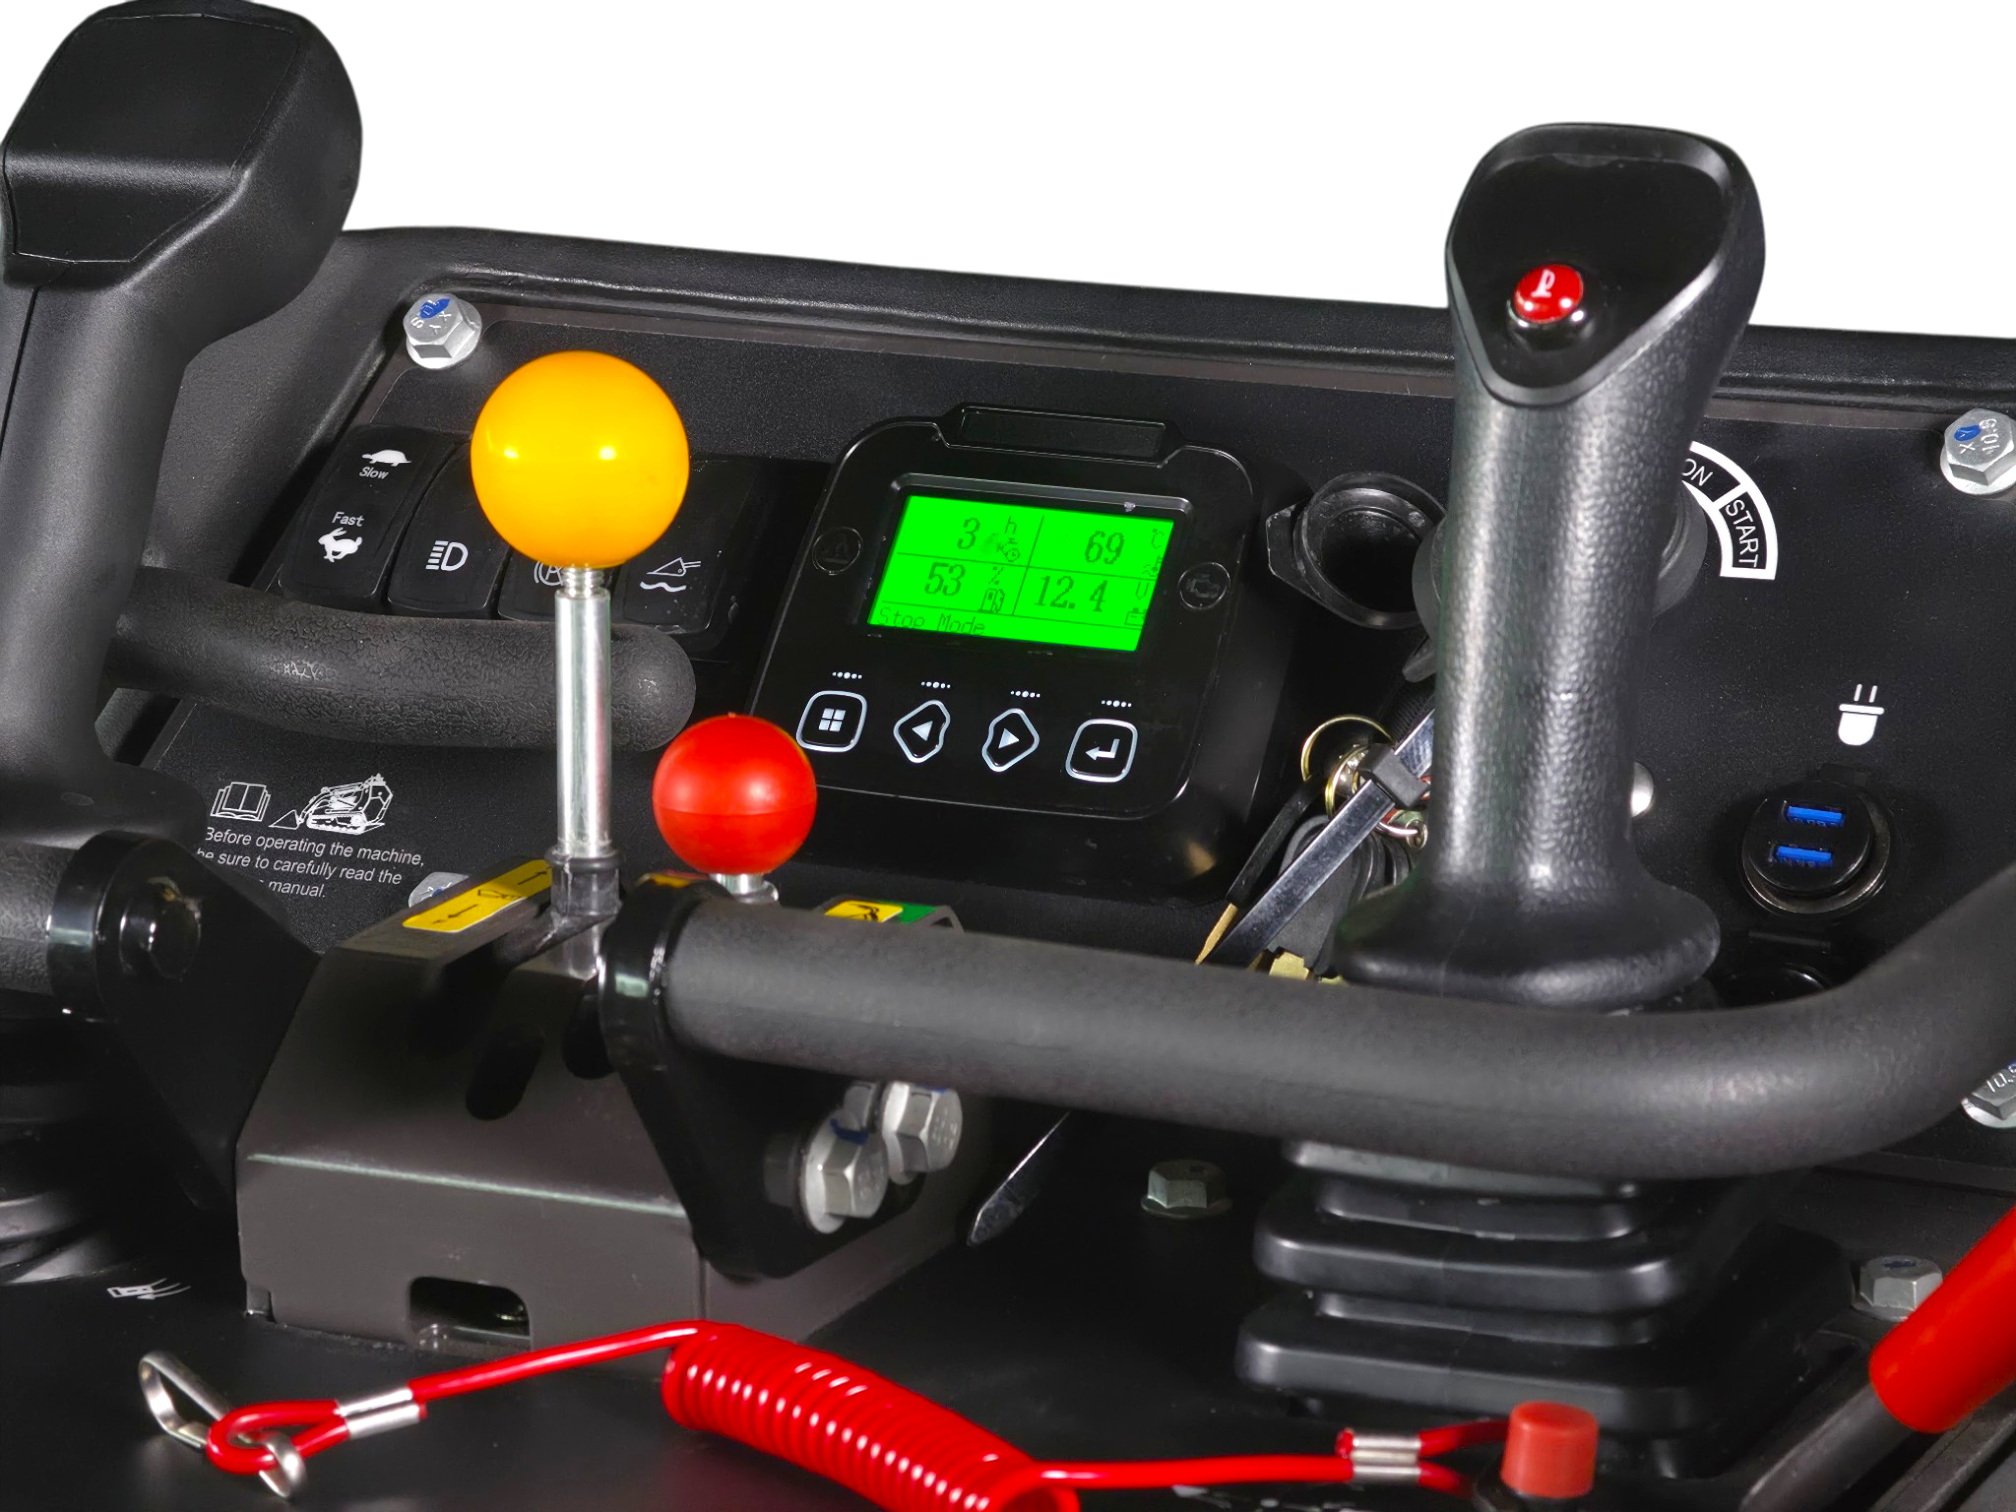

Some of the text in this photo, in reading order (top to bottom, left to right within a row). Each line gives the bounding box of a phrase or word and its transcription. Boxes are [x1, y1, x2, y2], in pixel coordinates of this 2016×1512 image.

[359, 466, 389, 480] Slow
[331, 511, 365, 527] Fast
[957, 517, 981, 550] 3
[1725, 499, 1760, 568] START
[1084, 530, 1125, 565] 69
[924, 561, 967, 597] 53
[877, 606, 986, 636] Stop Mode
[205, 826, 425, 867] Before operating the machine,
[217, 852, 251, 868] sure
[254, 855, 270, 869] to
[273, 859, 337, 880] carefully
[339, 867, 376, 882] read
[378, 869, 403, 885] the
[268, 880, 326, 898] manual.
